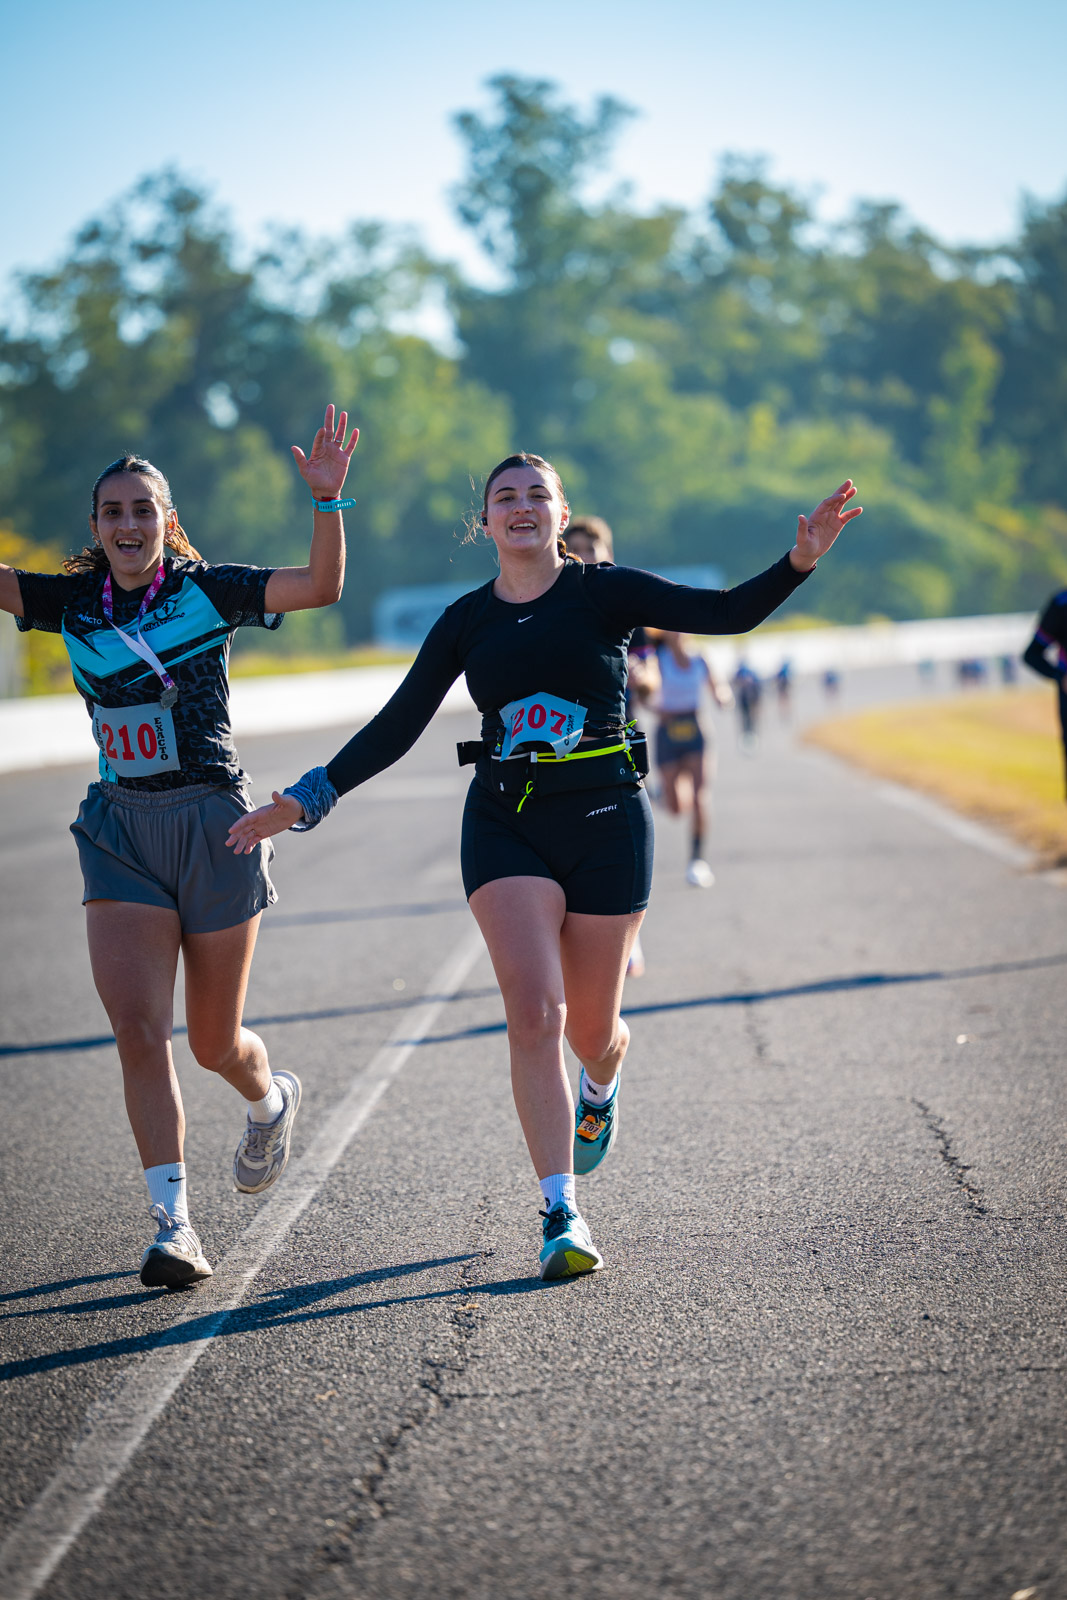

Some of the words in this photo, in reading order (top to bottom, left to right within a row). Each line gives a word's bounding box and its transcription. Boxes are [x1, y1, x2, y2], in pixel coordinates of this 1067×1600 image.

[154, 717, 169, 761] EXACTO
[511, 703, 567, 739] 207
[101, 723, 158, 761] 210
[583, 1122, 600, 1133] 207
